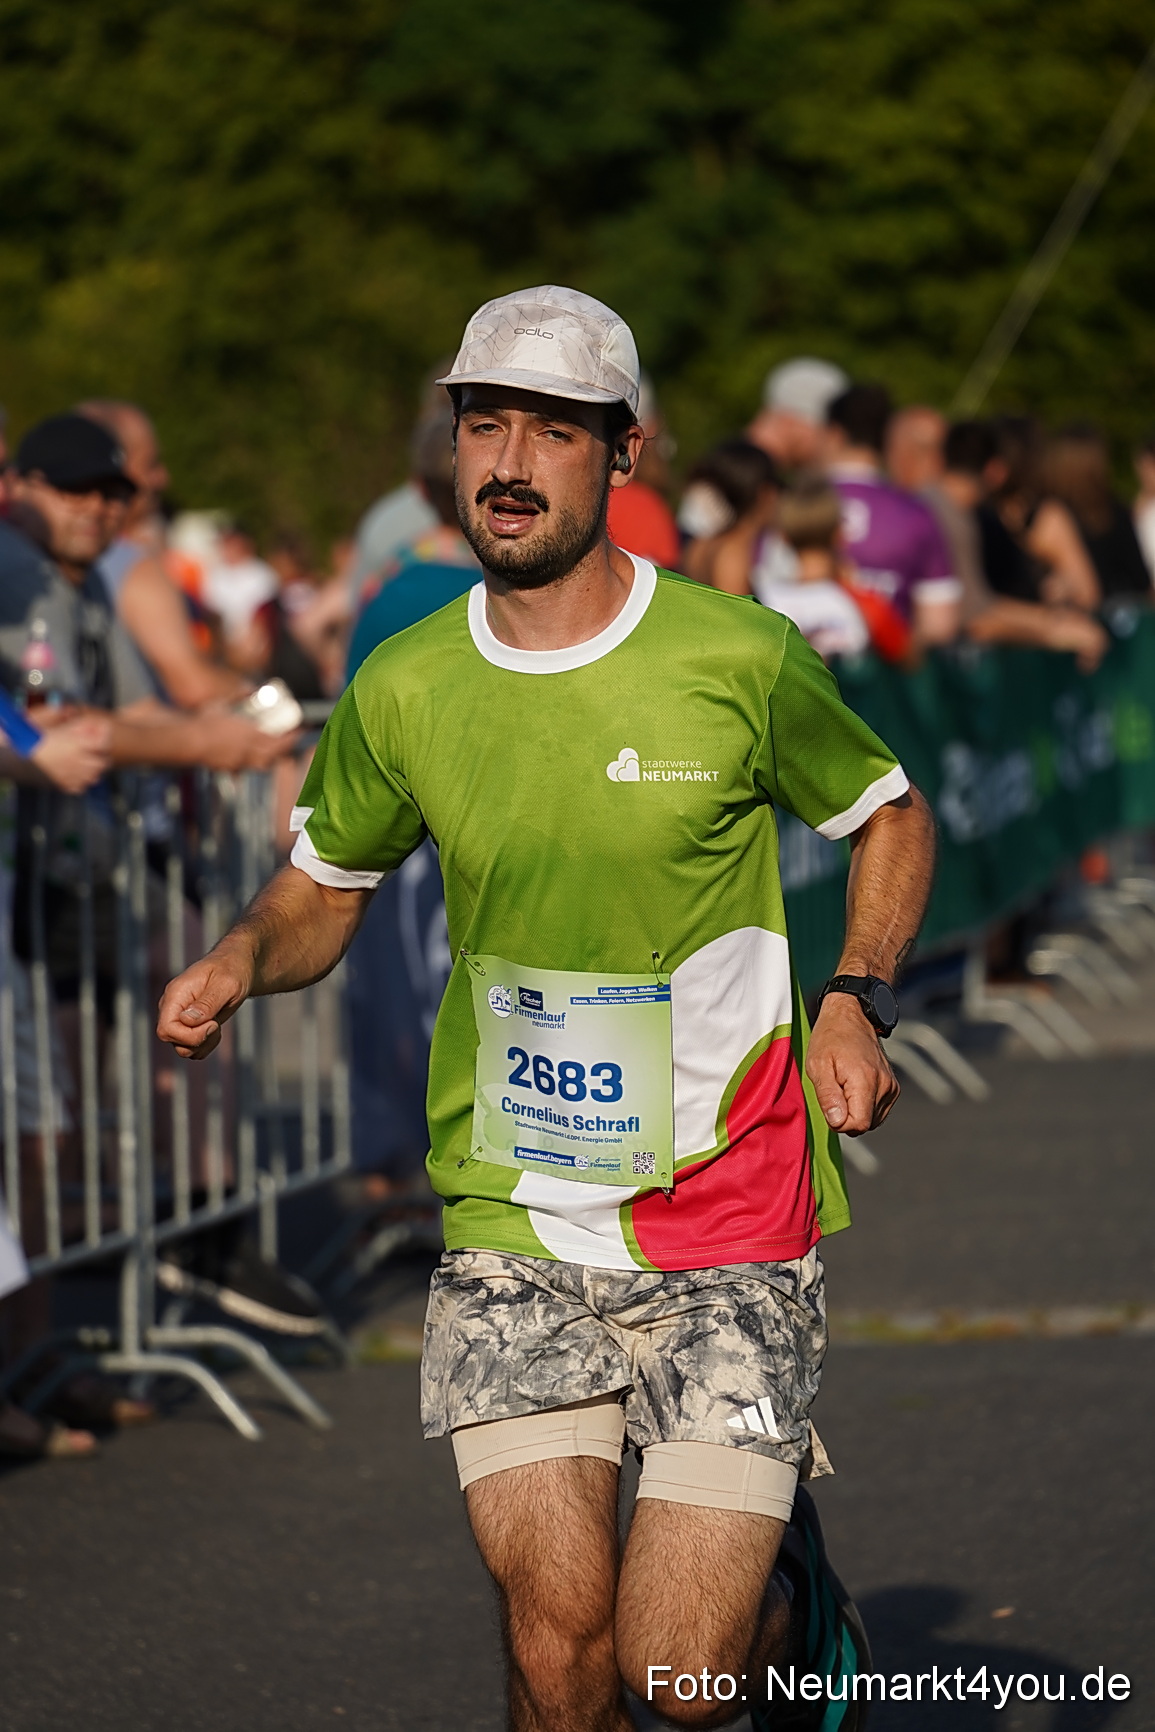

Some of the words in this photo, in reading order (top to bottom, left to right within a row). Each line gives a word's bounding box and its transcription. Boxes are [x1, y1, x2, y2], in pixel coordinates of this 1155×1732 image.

[514, 328, 554, 340] odlo
[642, 759, 702, 769] stadtwerke
[642, 770, 720, 782] NEUMARKT
[514, 1004, 567, 1022] Firmenlauf
[532, 1020, 566, 1030] neumarkt
[507, 1046, 623, 1103] 2683
[501, 1096, 570, 1128] Cornelius
[573, 1114, 640, 1133] Schrafl
[514, 1120, 542, 1132] Stadtwerke
[541, 1127, 565, 1138] Neumarkt
[582, 1136, 604, 1144] Energie
[516, 1149, 573, 1166] firmenlauf.bayern
